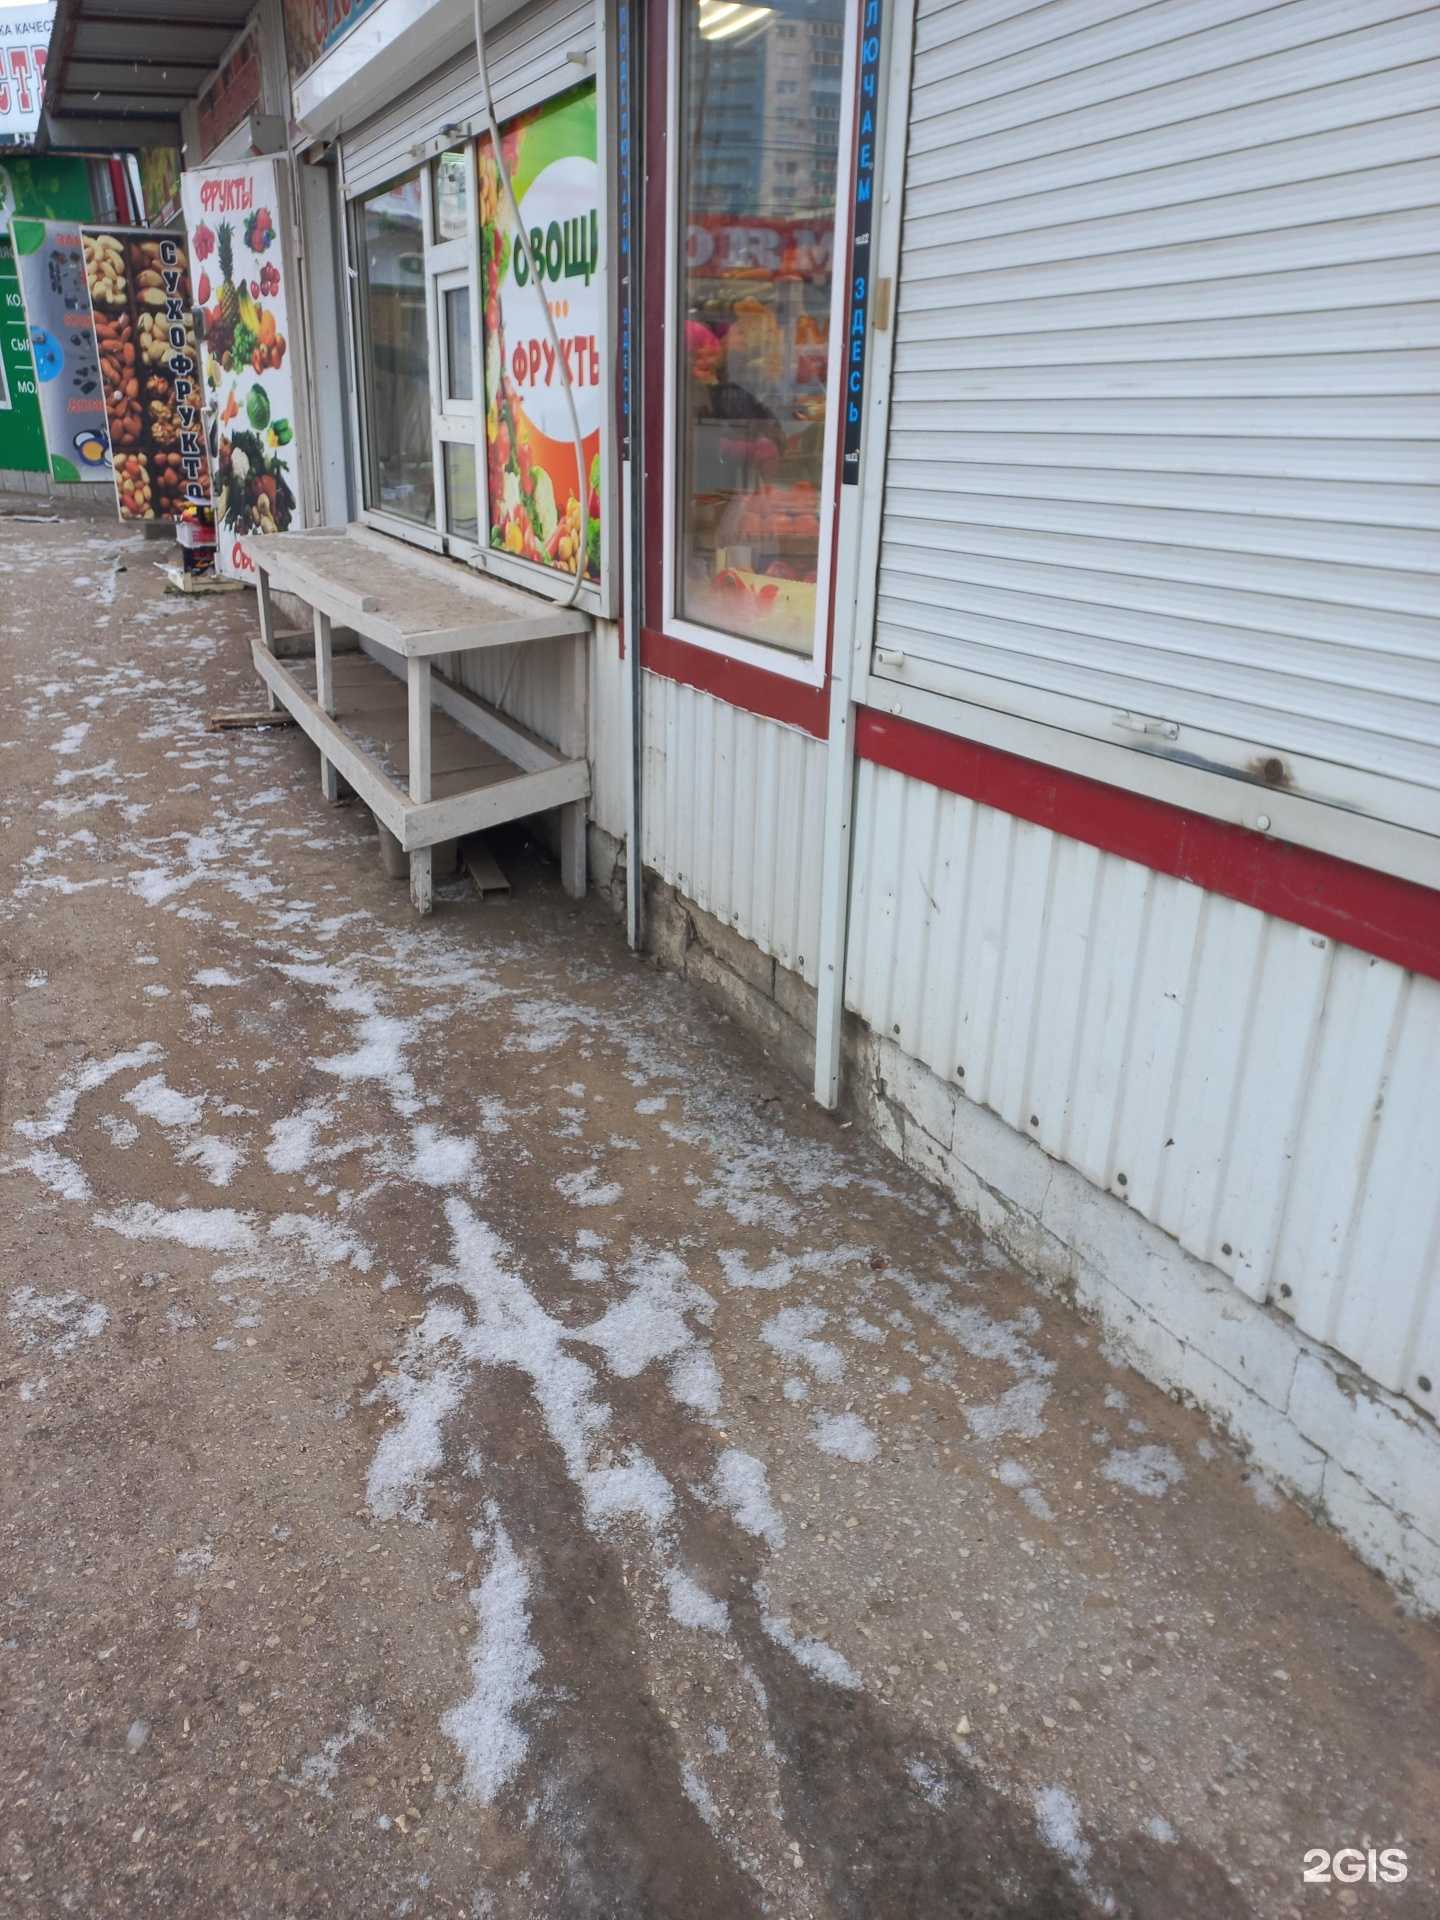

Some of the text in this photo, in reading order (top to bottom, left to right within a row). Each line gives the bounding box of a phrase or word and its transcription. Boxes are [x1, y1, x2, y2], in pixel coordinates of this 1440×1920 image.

[200, 176, 254, 213] ФРУКТЫ
[6, 293, 23, 308] КО
[848, 276, 865, 423] ЗДЕСЬ
